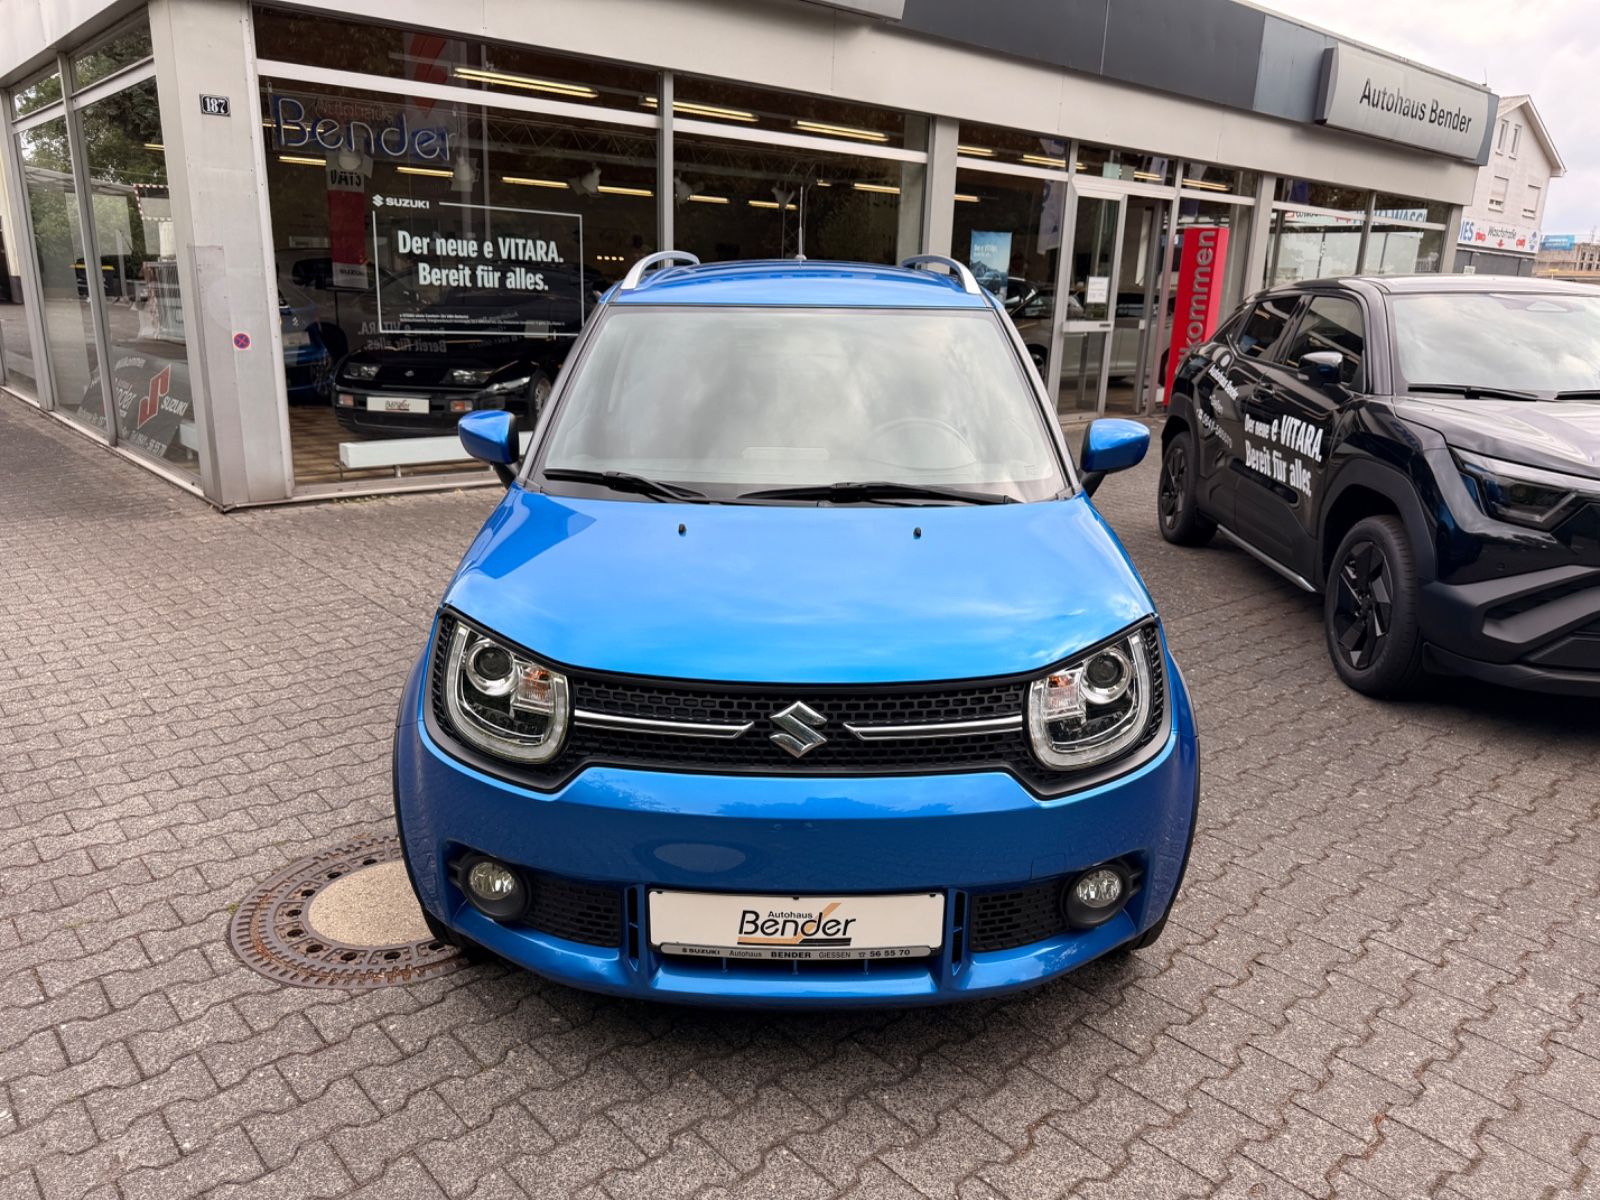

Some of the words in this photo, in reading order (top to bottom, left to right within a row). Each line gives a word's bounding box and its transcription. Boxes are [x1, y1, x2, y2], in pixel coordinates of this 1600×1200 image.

[205, 97, 226, 114] 187
[1360, 78, 1427, 121] Autohaus
[1428, 98, 1472, 133] Bender
[274, 96, 456, 161] Bender
[385, 196, 430, 209] SUZUKI
[397, 229, 430, 255] Der
[435, 235, 479, 258] neue
[483, 241, 494, 259] e
[498, 236, 564, 263] VITARA.
[418, 262, 472, 287] Bereit
[475, 264, 501, 288] für
[505, 266, 549, 291] alles.
[160, 395, 189, 416] SUZUKI
[1244, 414, 1255, 433] Der
[1271, 418, 1279, 442] e
[1280, 414, 1324, 462] VITARA.
[1245, 440, 1271, 476] Bereit
[1272, 449, 1287, 483] für
[1289, 458, 1312, 497] alles.
[738, 909, 856, 937] Bender
[767, 910, 813, 919] Autohaus
[688, 947, 720, 956] SUZUKI
[729, 949, 763, 958] Autohaus
[770, 951, 812, 959] BENDER
[818, 951, 851, 959] GIESSEN
[869, 950, 882, 958] 56
[883, 949, 896, 957] 55
[898, 948, 911, 956] 70
